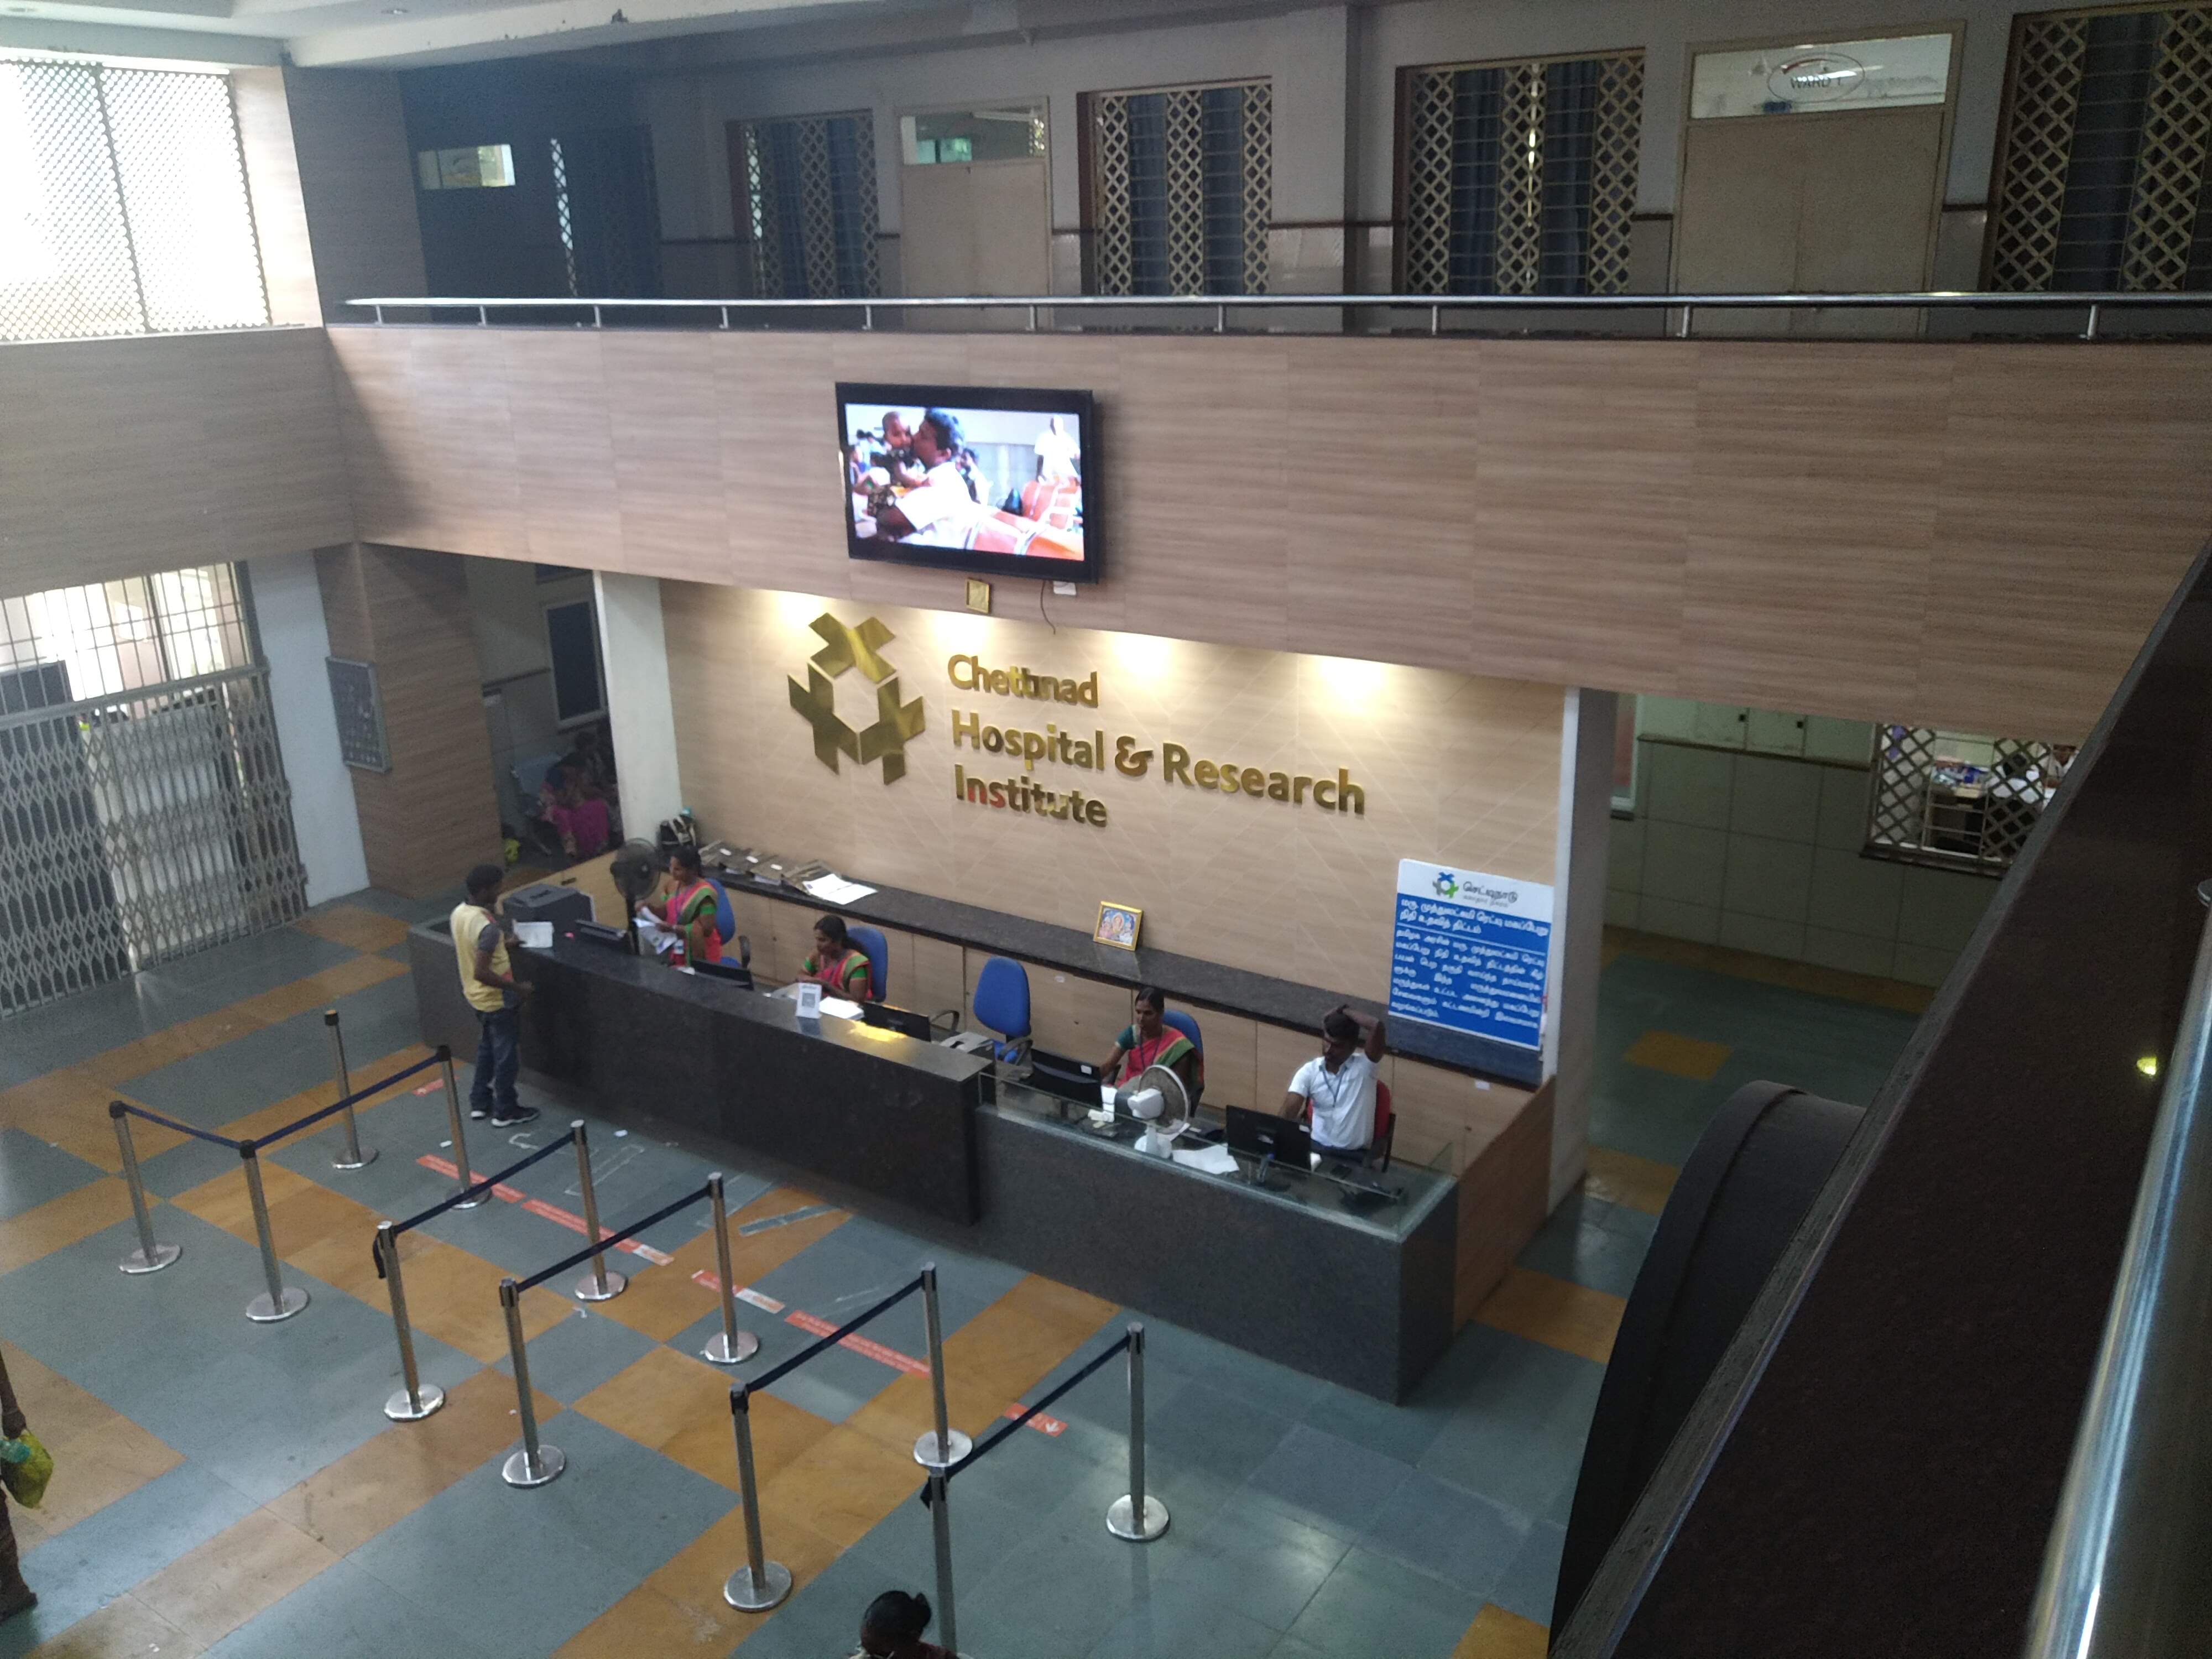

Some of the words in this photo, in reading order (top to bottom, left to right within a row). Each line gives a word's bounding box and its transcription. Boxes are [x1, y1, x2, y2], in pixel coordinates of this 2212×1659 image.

[947, 654, 1098, 708] Chettinad
[951, 708, 1105, 772] Hospital
[1114, 735, 1154, 777] &
[1163, 741, 1365, 815] Research
[954, 764, 1108, 827] Institute
